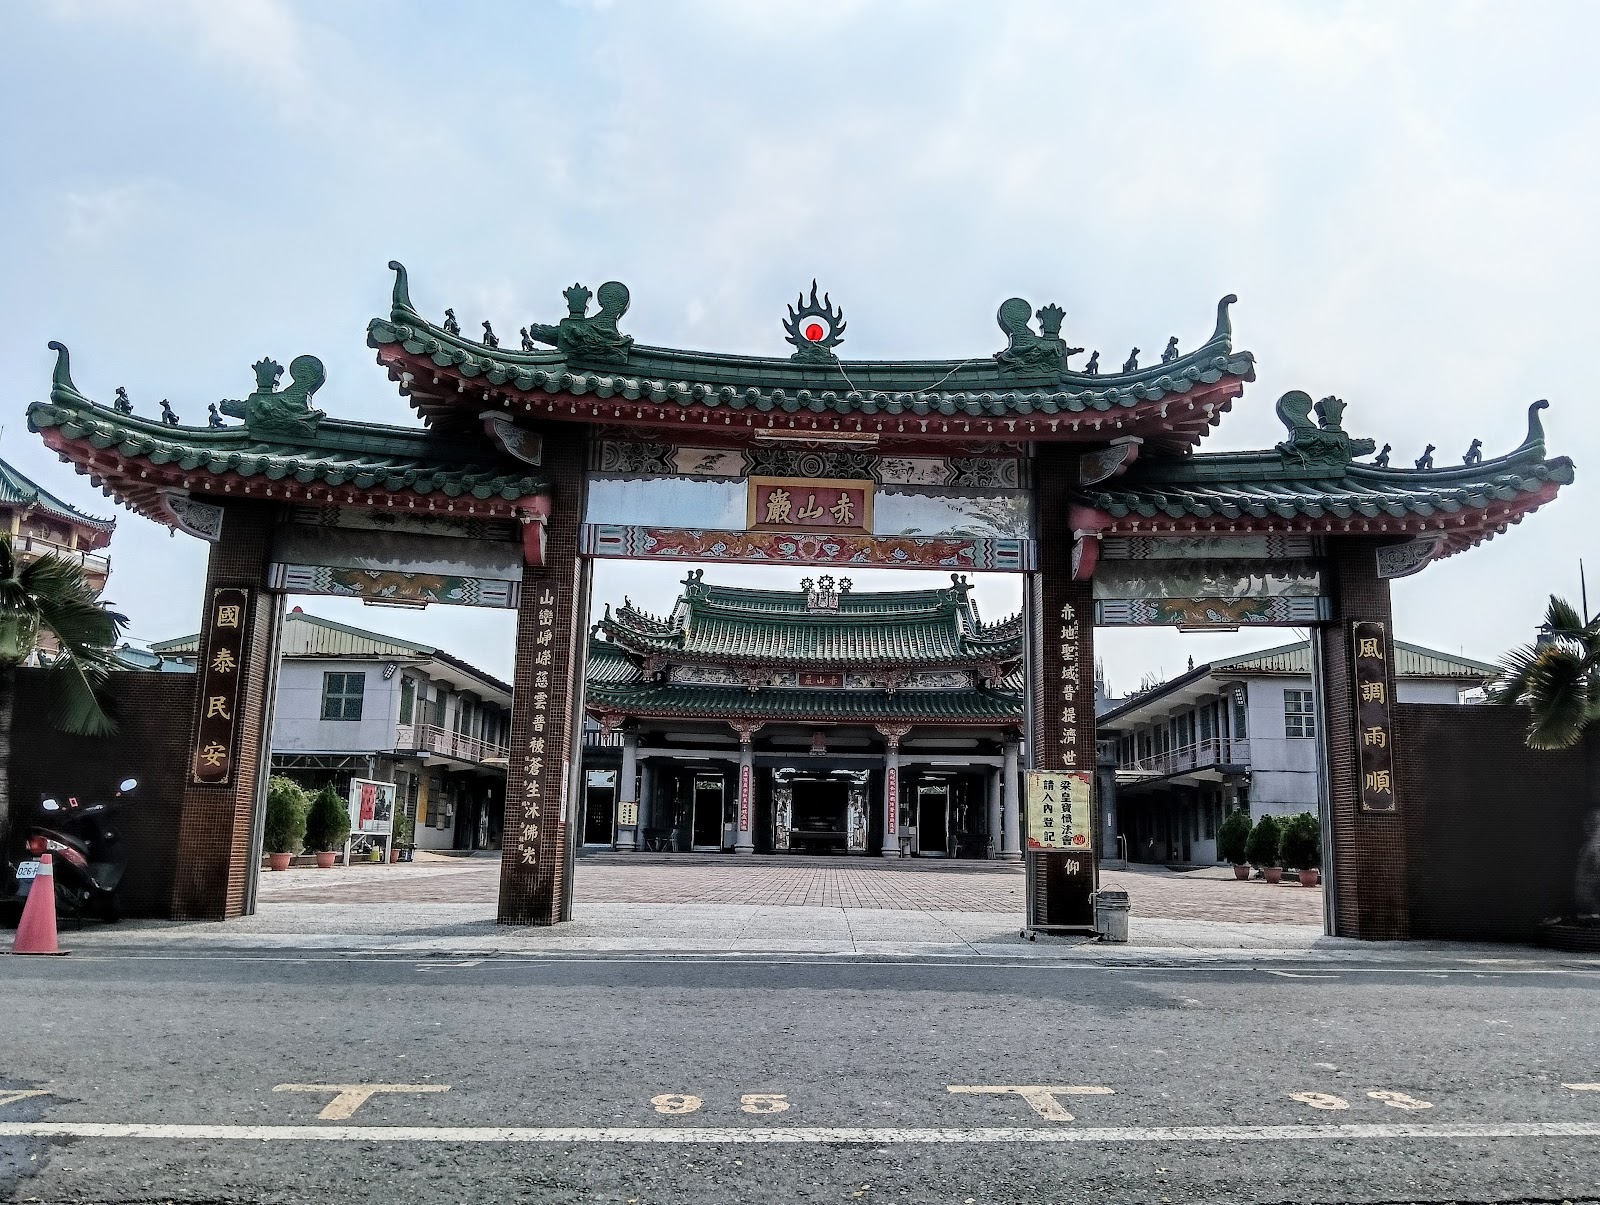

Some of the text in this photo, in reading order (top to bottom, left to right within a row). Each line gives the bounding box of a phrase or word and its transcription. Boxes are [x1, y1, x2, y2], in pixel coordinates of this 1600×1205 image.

[200, 605, 240, 767] 國泰民安
[1358, 637, 1392, 795] 風調雨順
